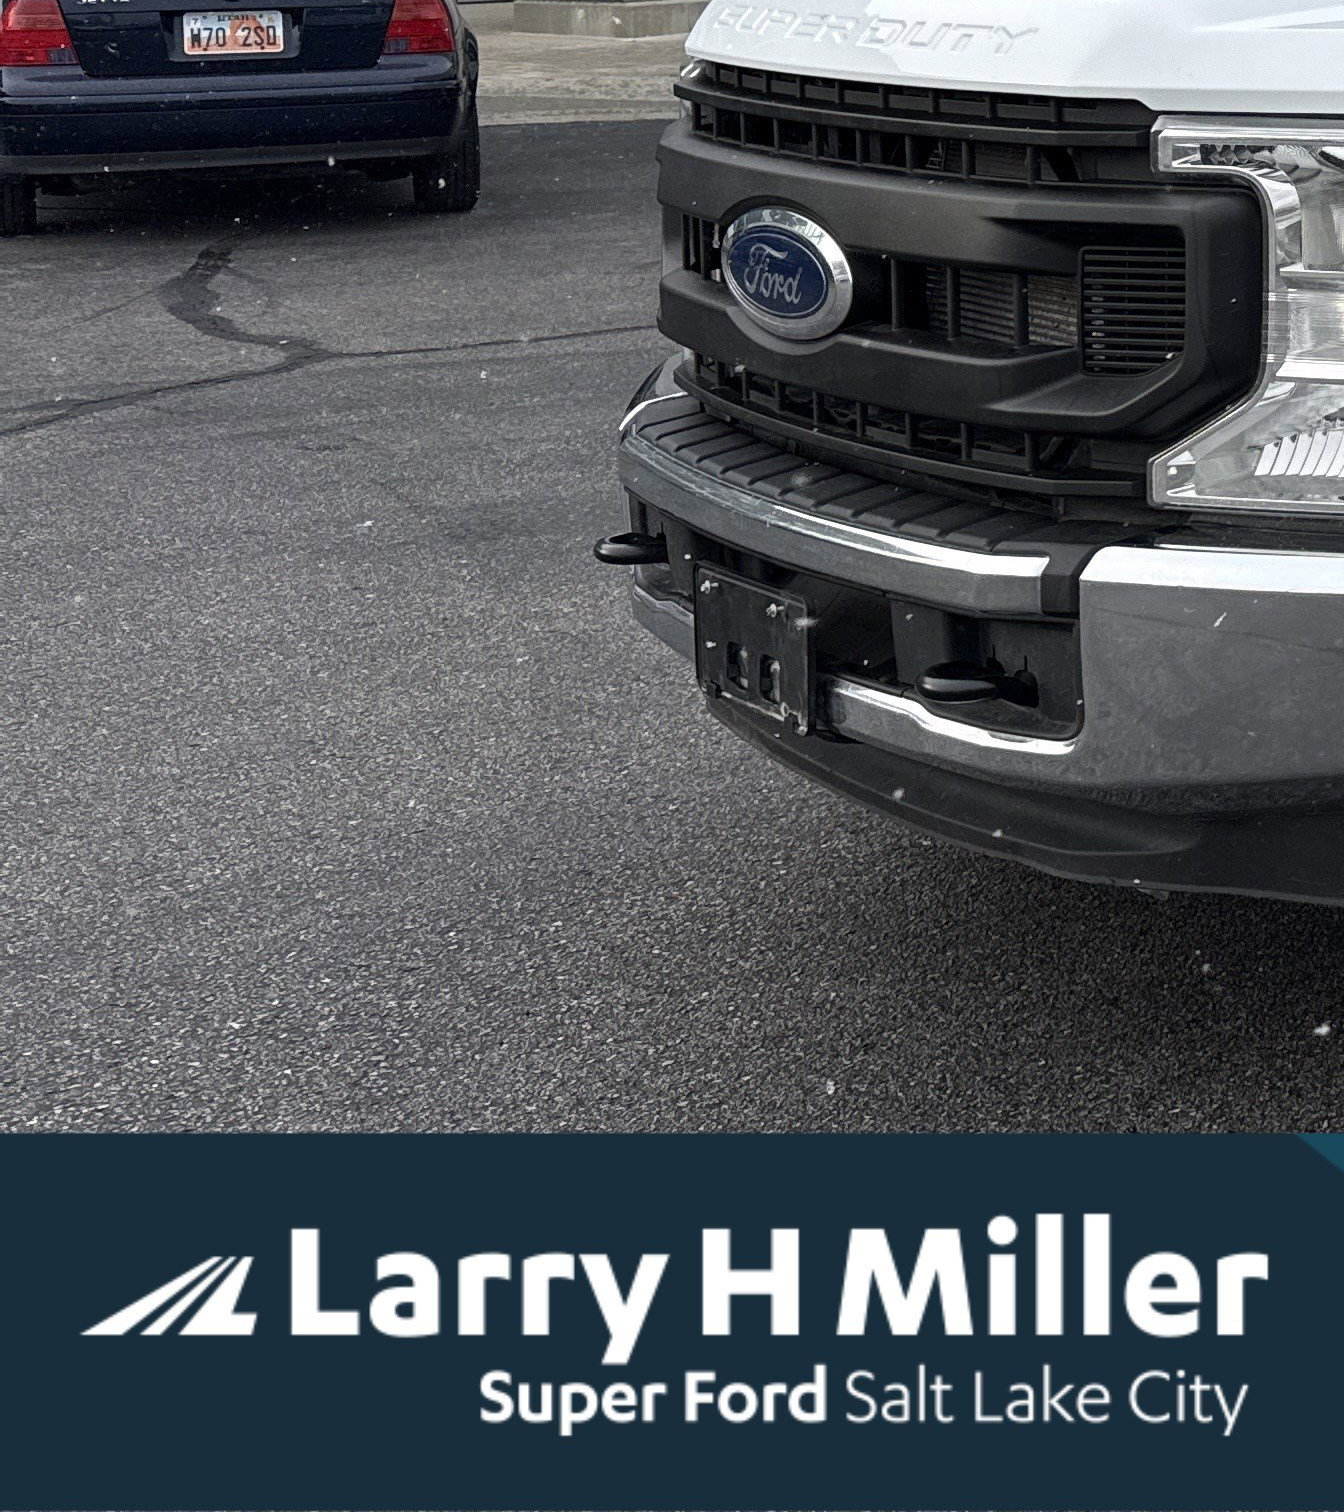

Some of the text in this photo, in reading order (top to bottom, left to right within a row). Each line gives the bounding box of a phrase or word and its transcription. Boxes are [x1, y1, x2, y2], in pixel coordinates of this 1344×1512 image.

[713, 4, 1040, 55] SUPER DUTY
[743, 242, 803, 305] Ford
